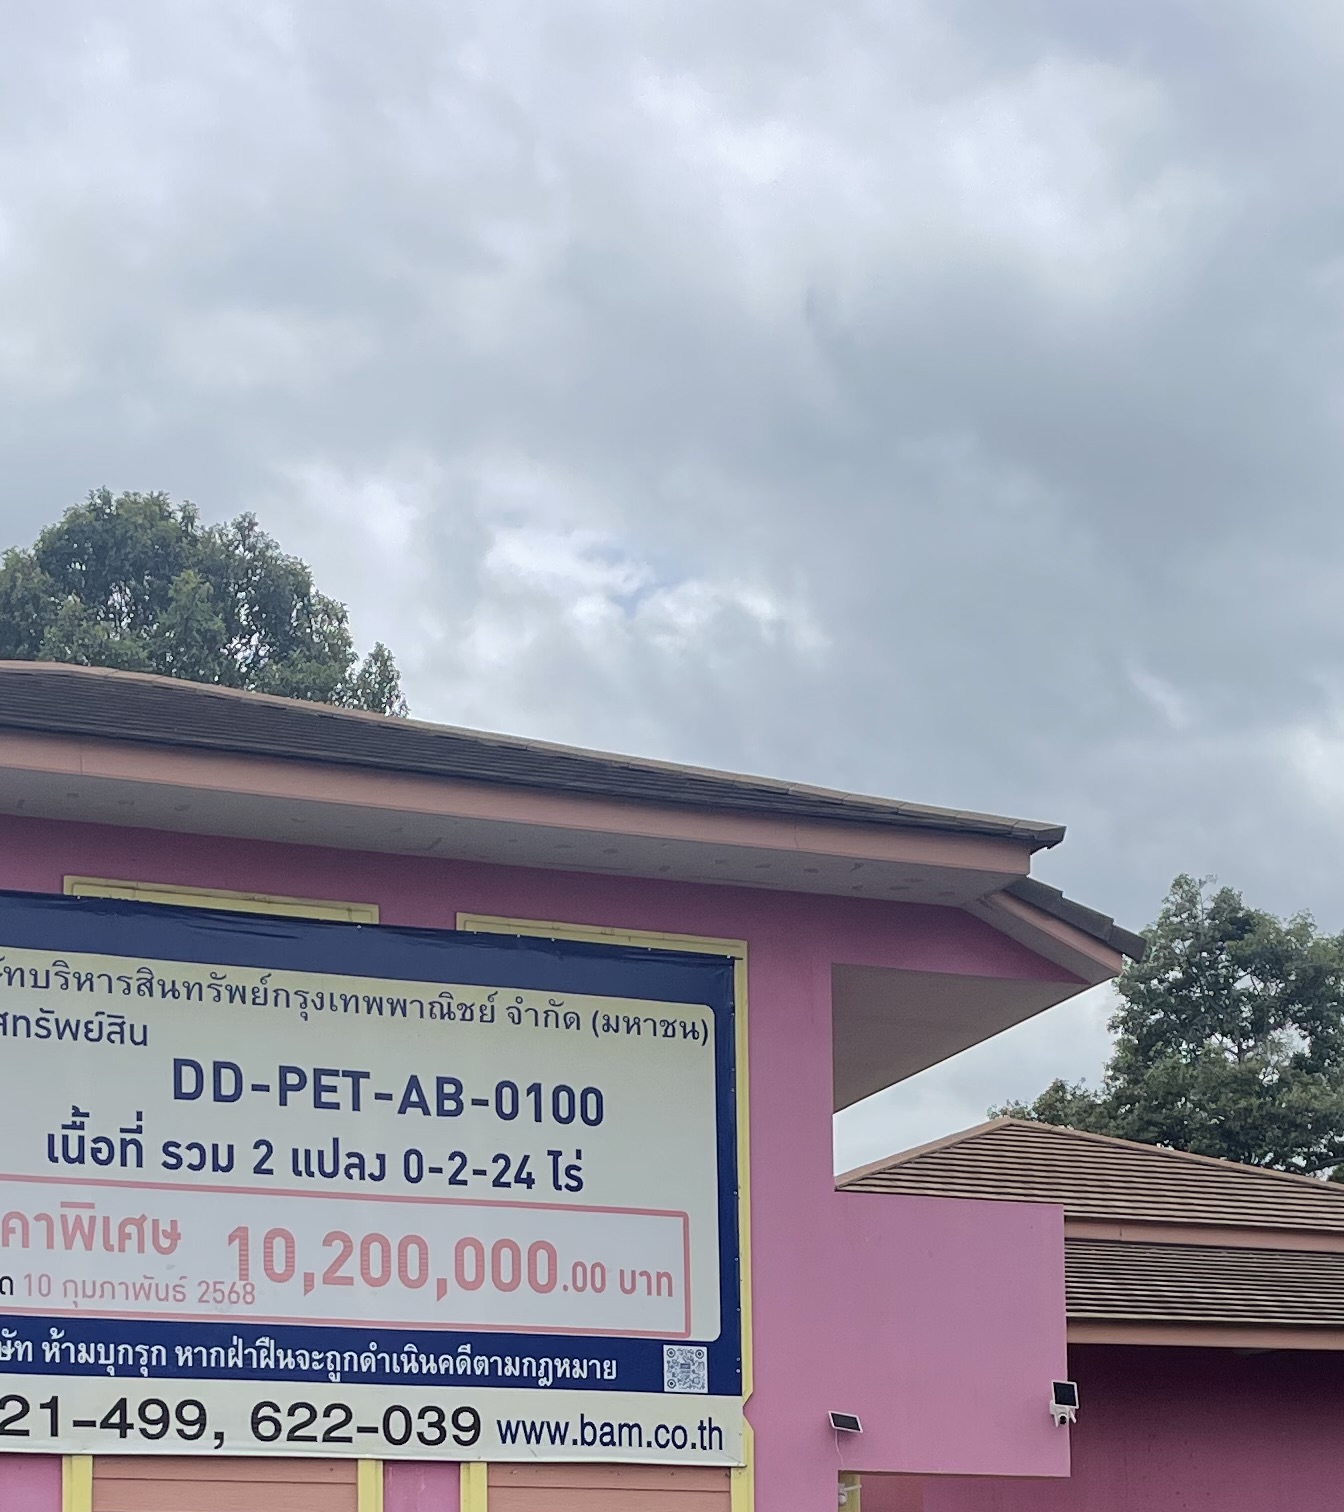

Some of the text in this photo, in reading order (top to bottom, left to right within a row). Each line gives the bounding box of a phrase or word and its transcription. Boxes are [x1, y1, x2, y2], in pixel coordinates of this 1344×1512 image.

[507, 997, 581, 1031] จำกัด
[592, 1009, 709, 1046] (มหาชน)
[172, 1057, 605, 1127] DD-PET-AB-0100
[47, 1105, 584, 1192] เนื้อที่ รวม 2 แปลง 0-2-24 ไร่
[22, 1273, 52, 1298] 10
[62, 1275, 187, 1308] กุมภาพันธ์
[196, 1279, 256, 1305] 2568
[227, 1225, 607, 1302] 10,200,000.00
[618, 1268, 674, 1298] บาท
[41, 1327, 168, 1377] ห้ามบุกรุก
[175, 1335, 618, 1388] หากฝ่าฝืนจะถูกดำเนินคดีตามกฎหมาย
[249, 1400, 482, 1447] 622-039
[495, 1412, 725, 1451] www.bam.co.th
